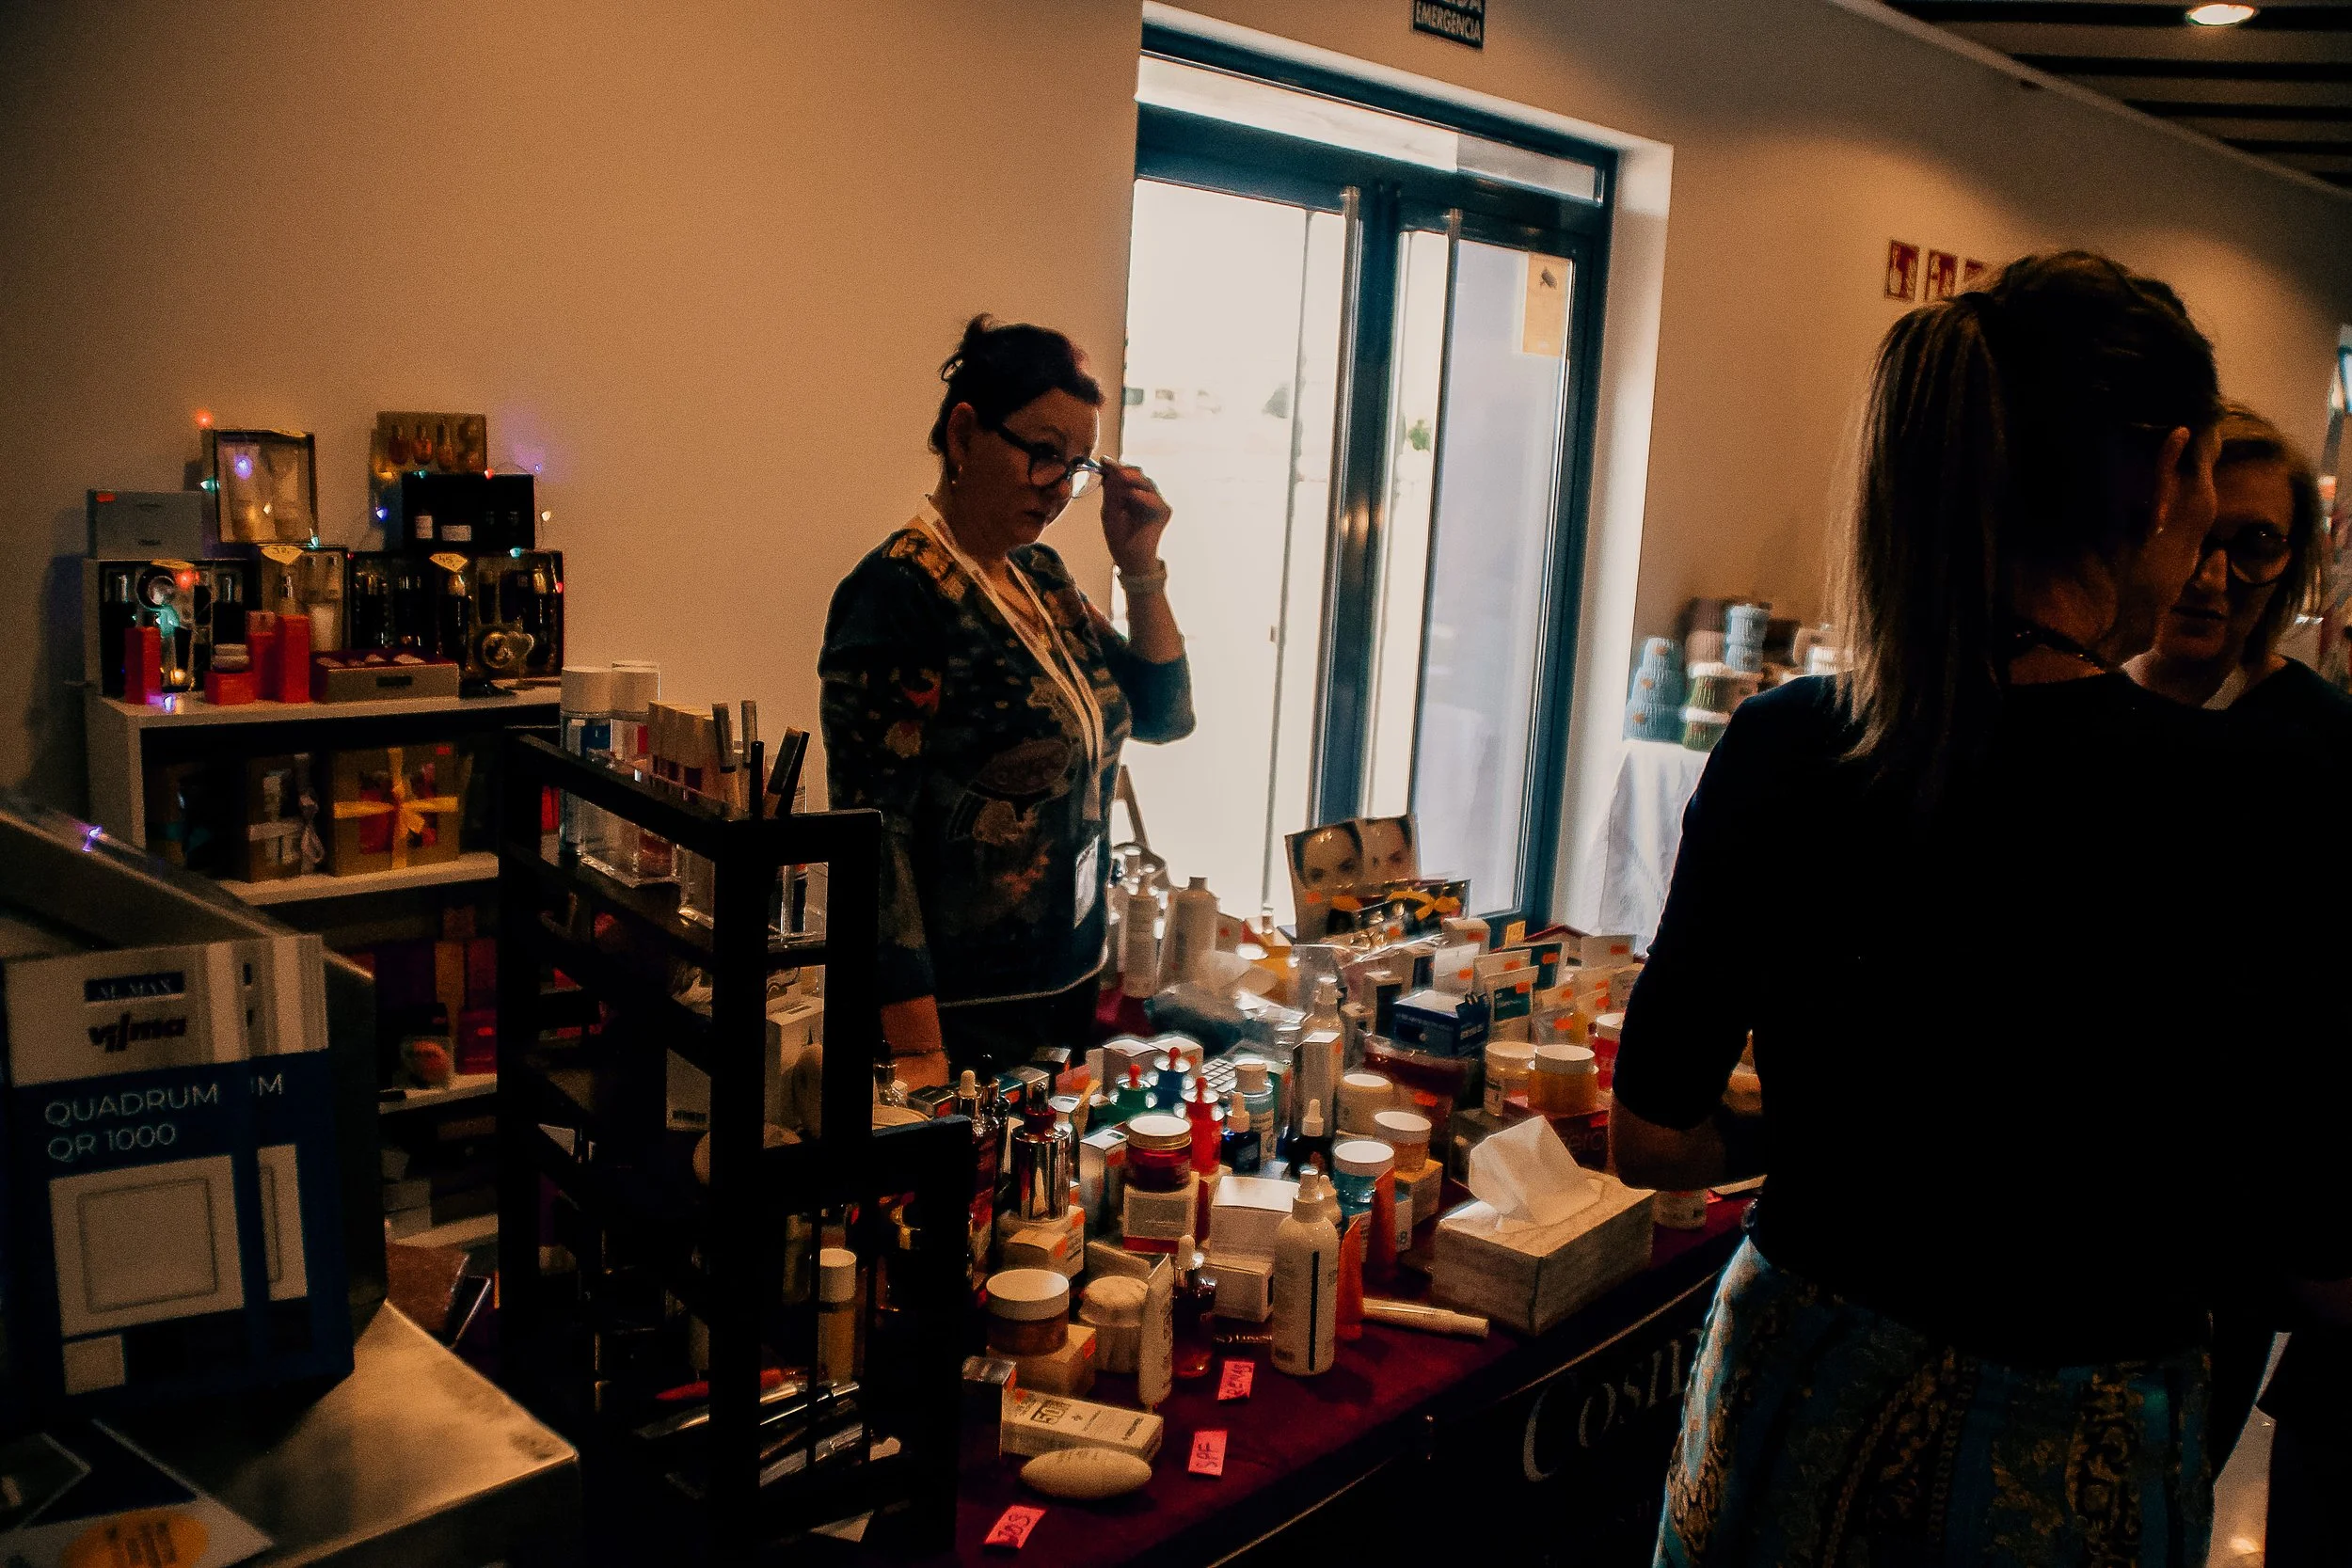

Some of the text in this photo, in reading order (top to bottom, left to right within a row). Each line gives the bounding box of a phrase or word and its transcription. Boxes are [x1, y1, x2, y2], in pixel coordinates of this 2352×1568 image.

[1415, 0, 1482, 41] EMERGENCIA
[44, 1083, 220, 1128] QUADRUM
[47, 1122, 177, 1164] QR 1000
[1195, 1441, 1219, 1471] SPF
